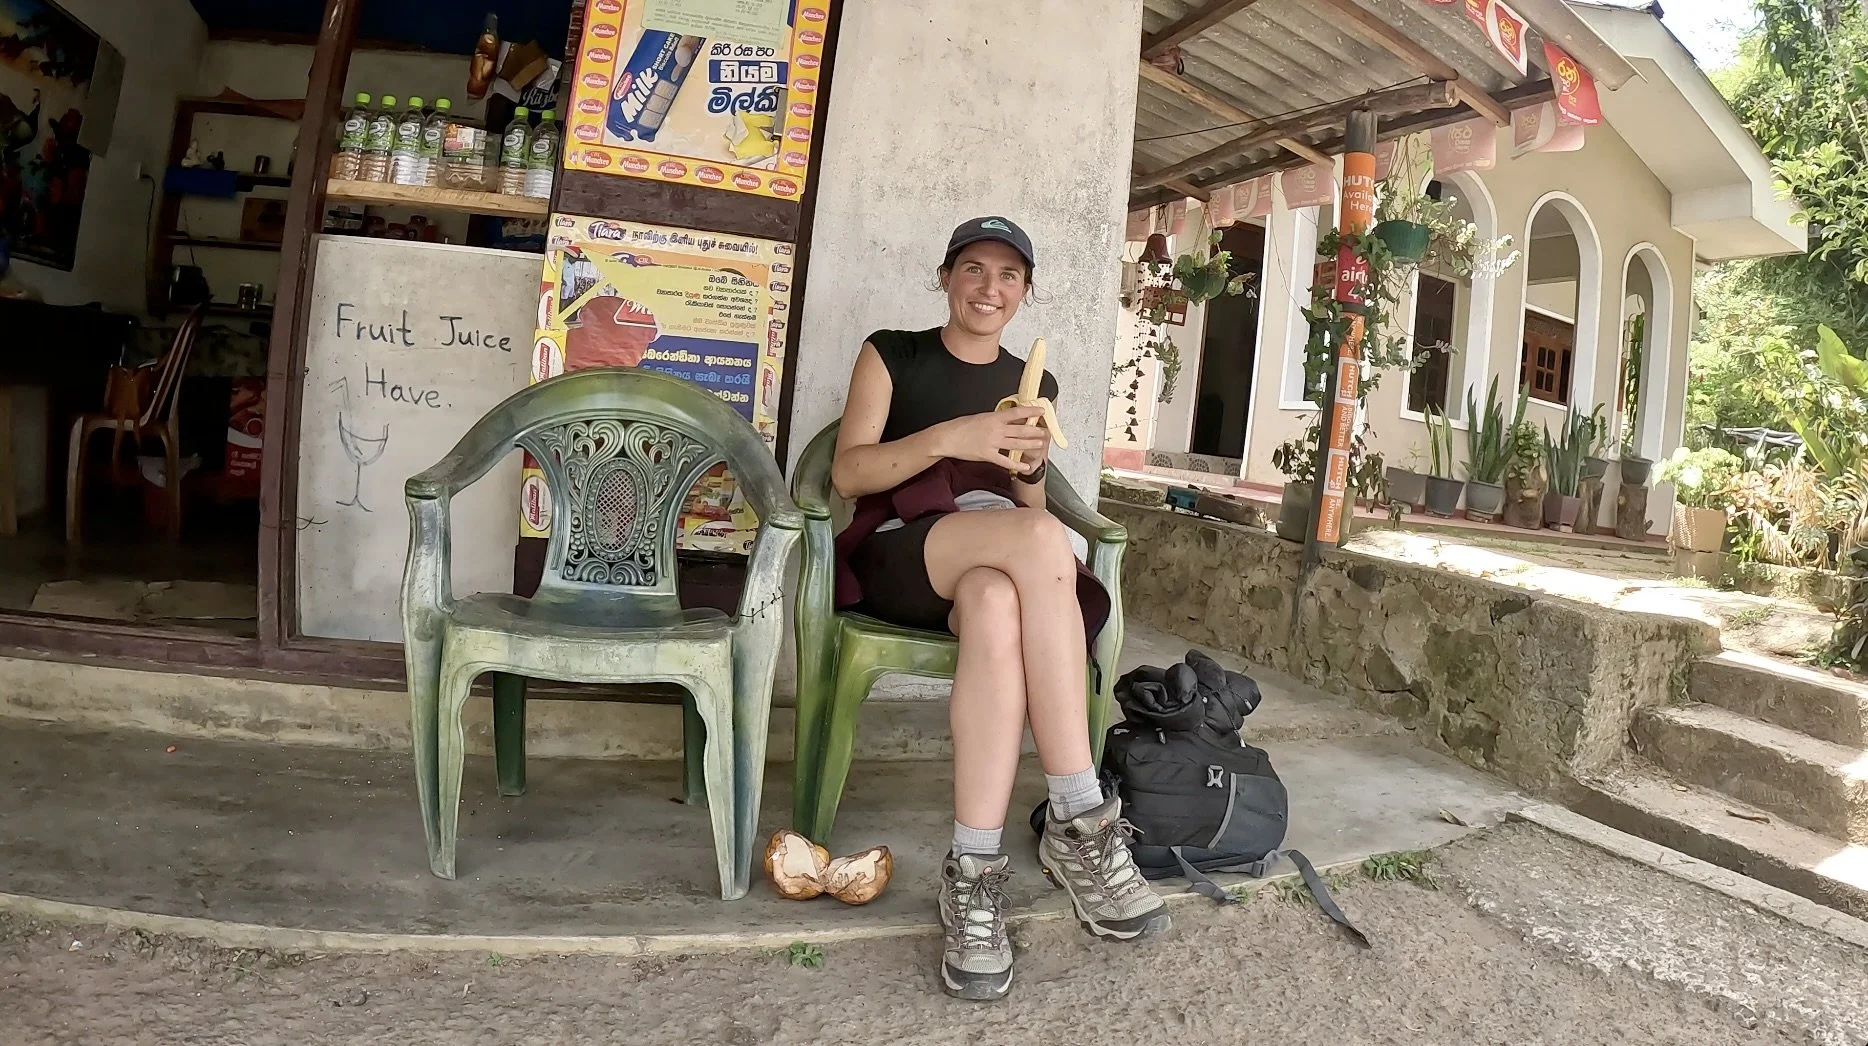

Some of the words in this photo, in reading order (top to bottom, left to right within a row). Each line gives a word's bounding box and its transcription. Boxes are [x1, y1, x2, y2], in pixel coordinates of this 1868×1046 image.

[621, 67, 658, 123] Milk
[622, 160, 648, 171] Munchee
[660, 165, 685, 176] Munchee
[698, 171, 722, 181] Munchee
[734, 176, 759, 187] Munchee
[772, 183, 796, 193] Munchee
[593, 222, 622, 239] Tiara
[336, 303, 415, 347] Fruit
[439, 315, 512, 352] Juice
[365, 362, 452, 408] Have.
[1347, 365, 1355, 398] HUTCH
[1337, 456, 1345, 489] HUTCH
